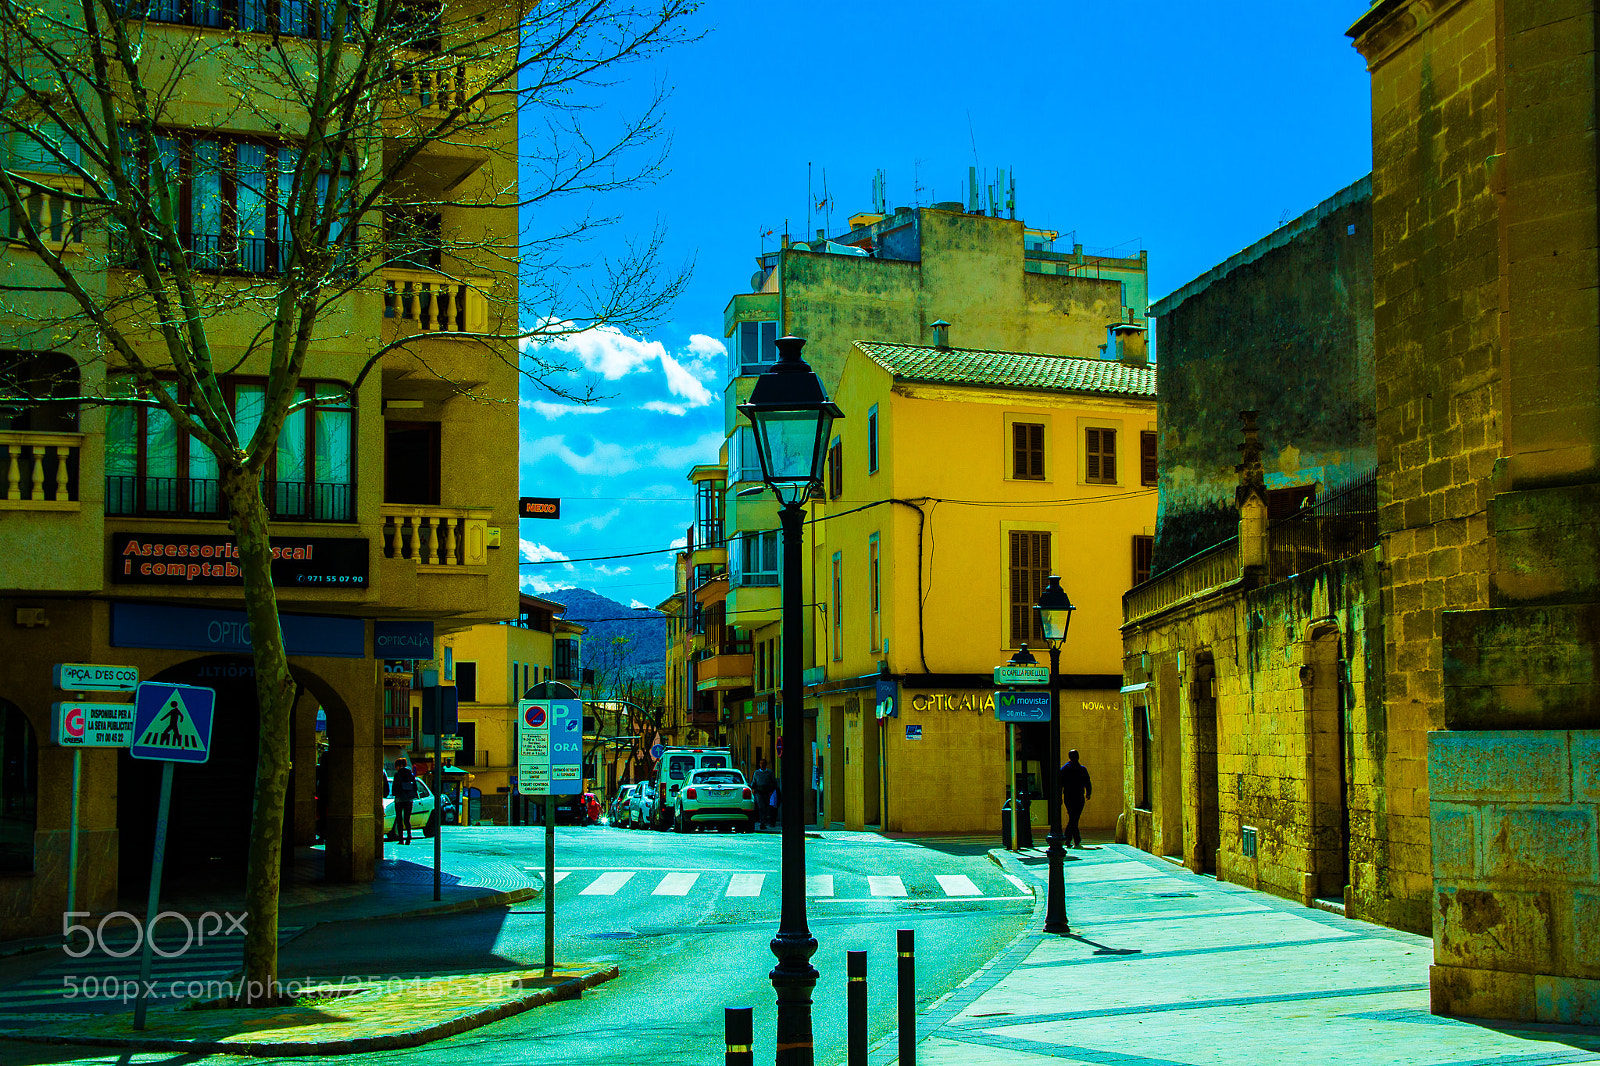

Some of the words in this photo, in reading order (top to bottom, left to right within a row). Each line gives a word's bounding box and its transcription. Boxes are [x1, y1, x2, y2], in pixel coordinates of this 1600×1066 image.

[526, 503, 557, 513] NEXO
[122, 540, 240, 558] Assessoria
[271, 544, 313, 560] scal
[124, 558, 132, 575] i
[325, 575, 337, 583] 55
[339, 575, 350, 583] 07
[352, 575, 364, 583] 90
[71, 669, 92, 682] PÇA.
[95, 670, 114, 680] D'ES
[116, 671, 136, 681] COS
[1017, 697, 1049, 705] movistar
[1082, 701, 1104, 710] NOVA
[118, 709, 127, 719] PER
[552, 704, 570, 726] P
[88, 720, 94, 730] LA
[95, 721, 106, 730] SEVA
[553, 743, 579, 752] ORA
